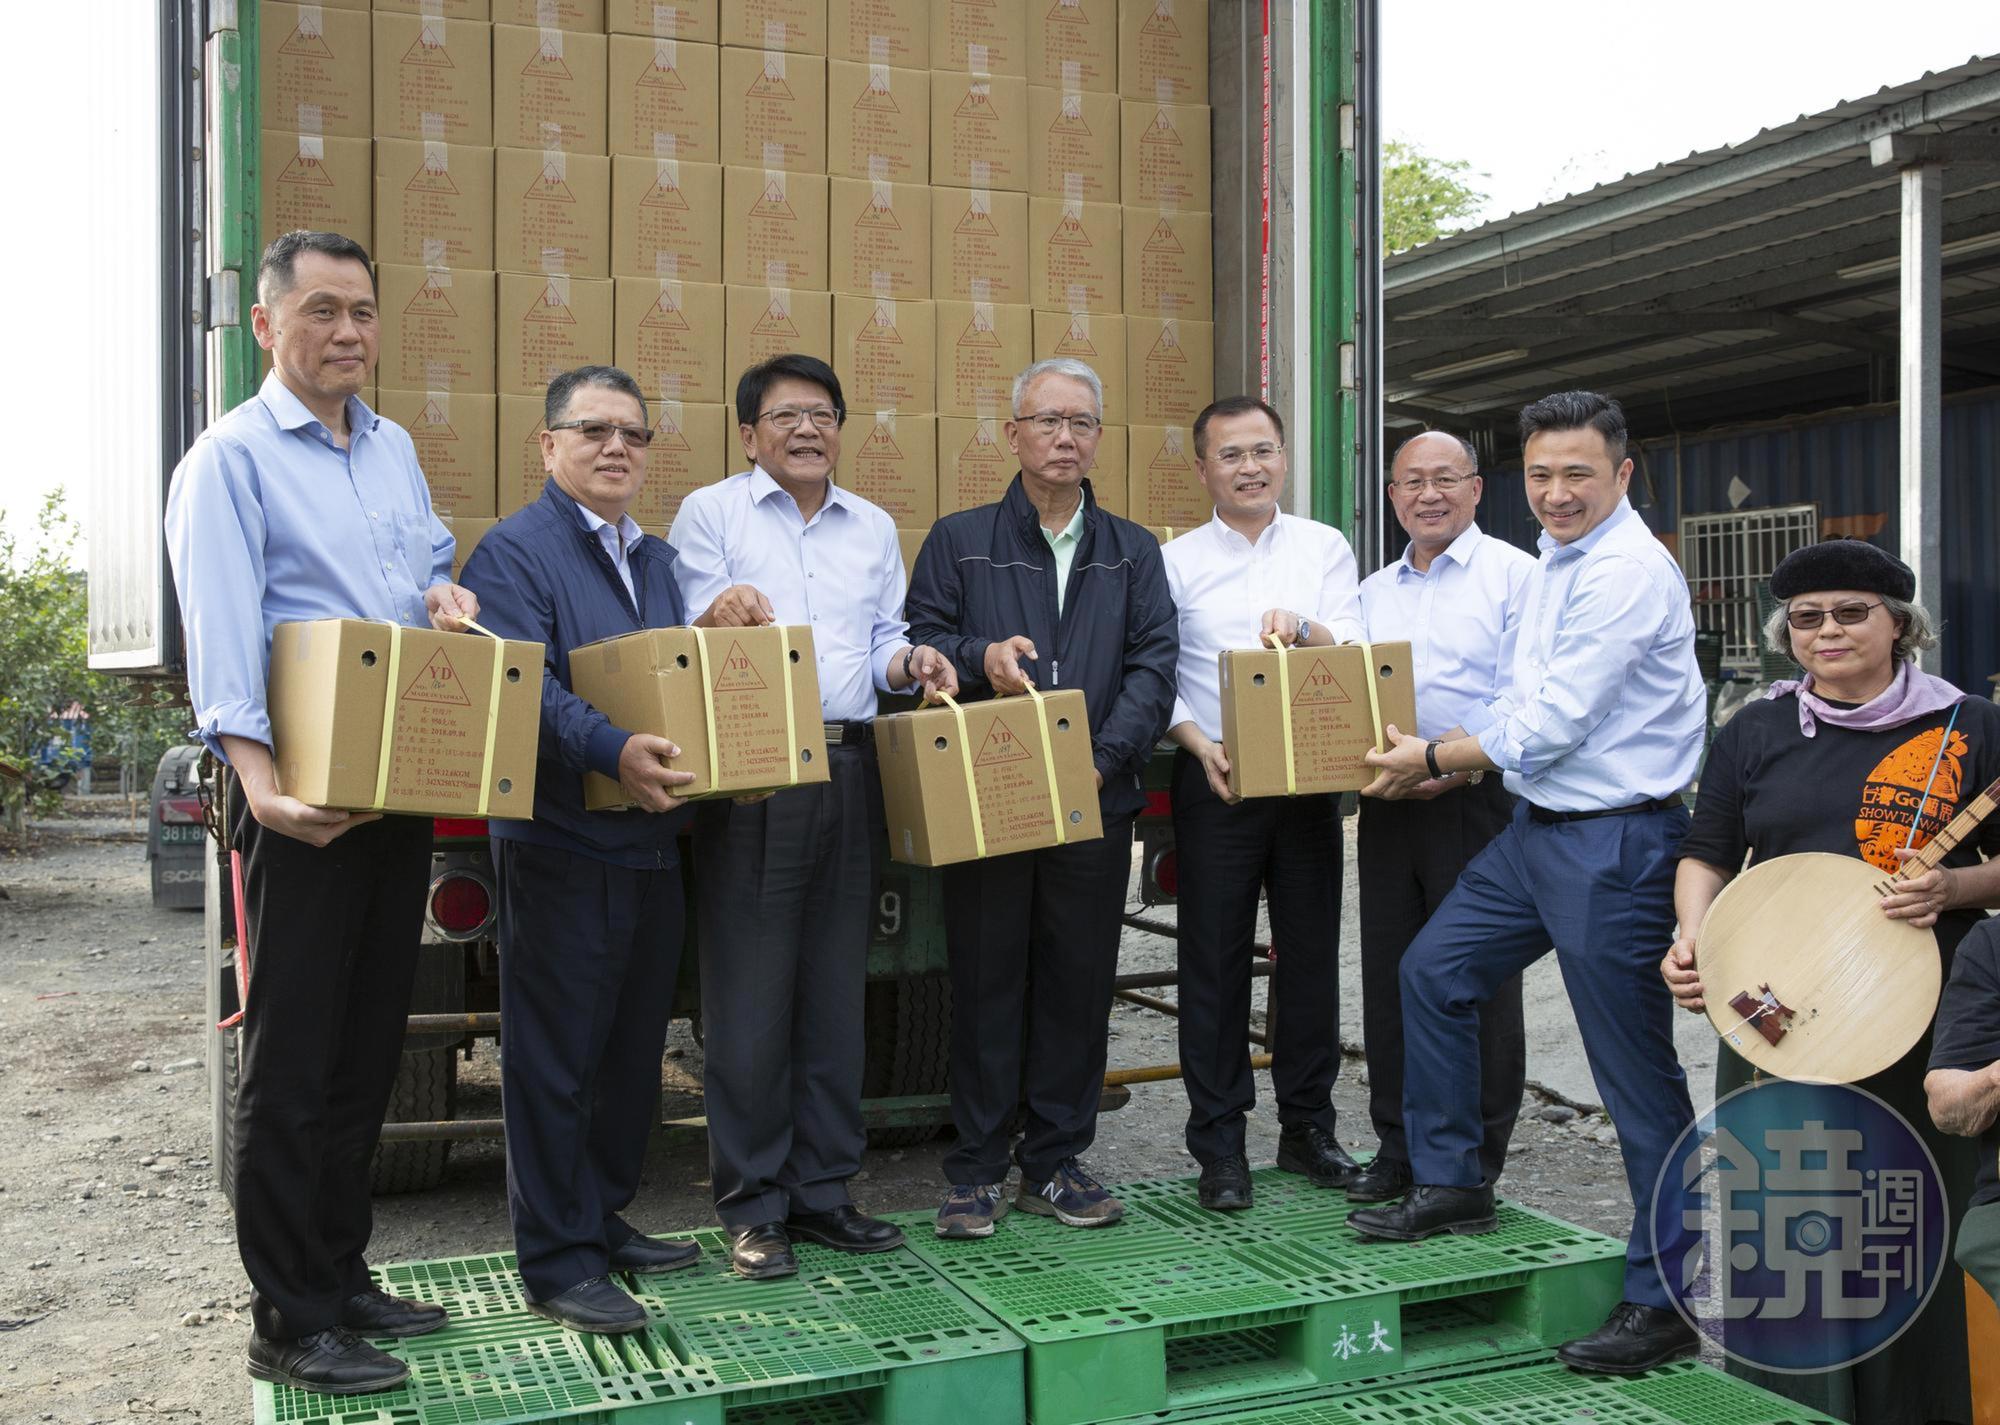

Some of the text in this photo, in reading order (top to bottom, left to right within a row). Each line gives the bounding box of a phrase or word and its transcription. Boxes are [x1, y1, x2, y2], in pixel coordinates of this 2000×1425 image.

[1155, 14, 1169, 23] YD
[420, 39, 438, 49] YD
[969, 94, 985, 105] YD
[1155, 120, 1170, 130] YD
[298, 157, 316, 168] YD
[426, 167, 444, 177] YD
[766, 192, 784, 202] YD
[969, 211, 985, 221] YD
[1064, 222, 1079, 232] YD
[1157, 229, 1172, 240] YD
[423, 289, 442, 300] YD
[543, 296, 560, 307] YD
[657, 302, 674, 313] YD
[768, 310, 785, 321] YD
[873, 317, 889, 327] YD
[423, 412, 442, 423] YD
[659, 424, 676, 434] YD
[873, 433, 889, 444] YD
[975, 437, 991, 447] YD
[730, 657, 749, 670] YD
[430, 665, 452, 680] YD
[1311, 674, 1332, 686] YD
[991, 732, 1011, 745] YD
[1859, 807, 1947, 834] SHOW TAWA
[161, 869, 206, 884] SCA
[880, 891, 901, 935] 9
